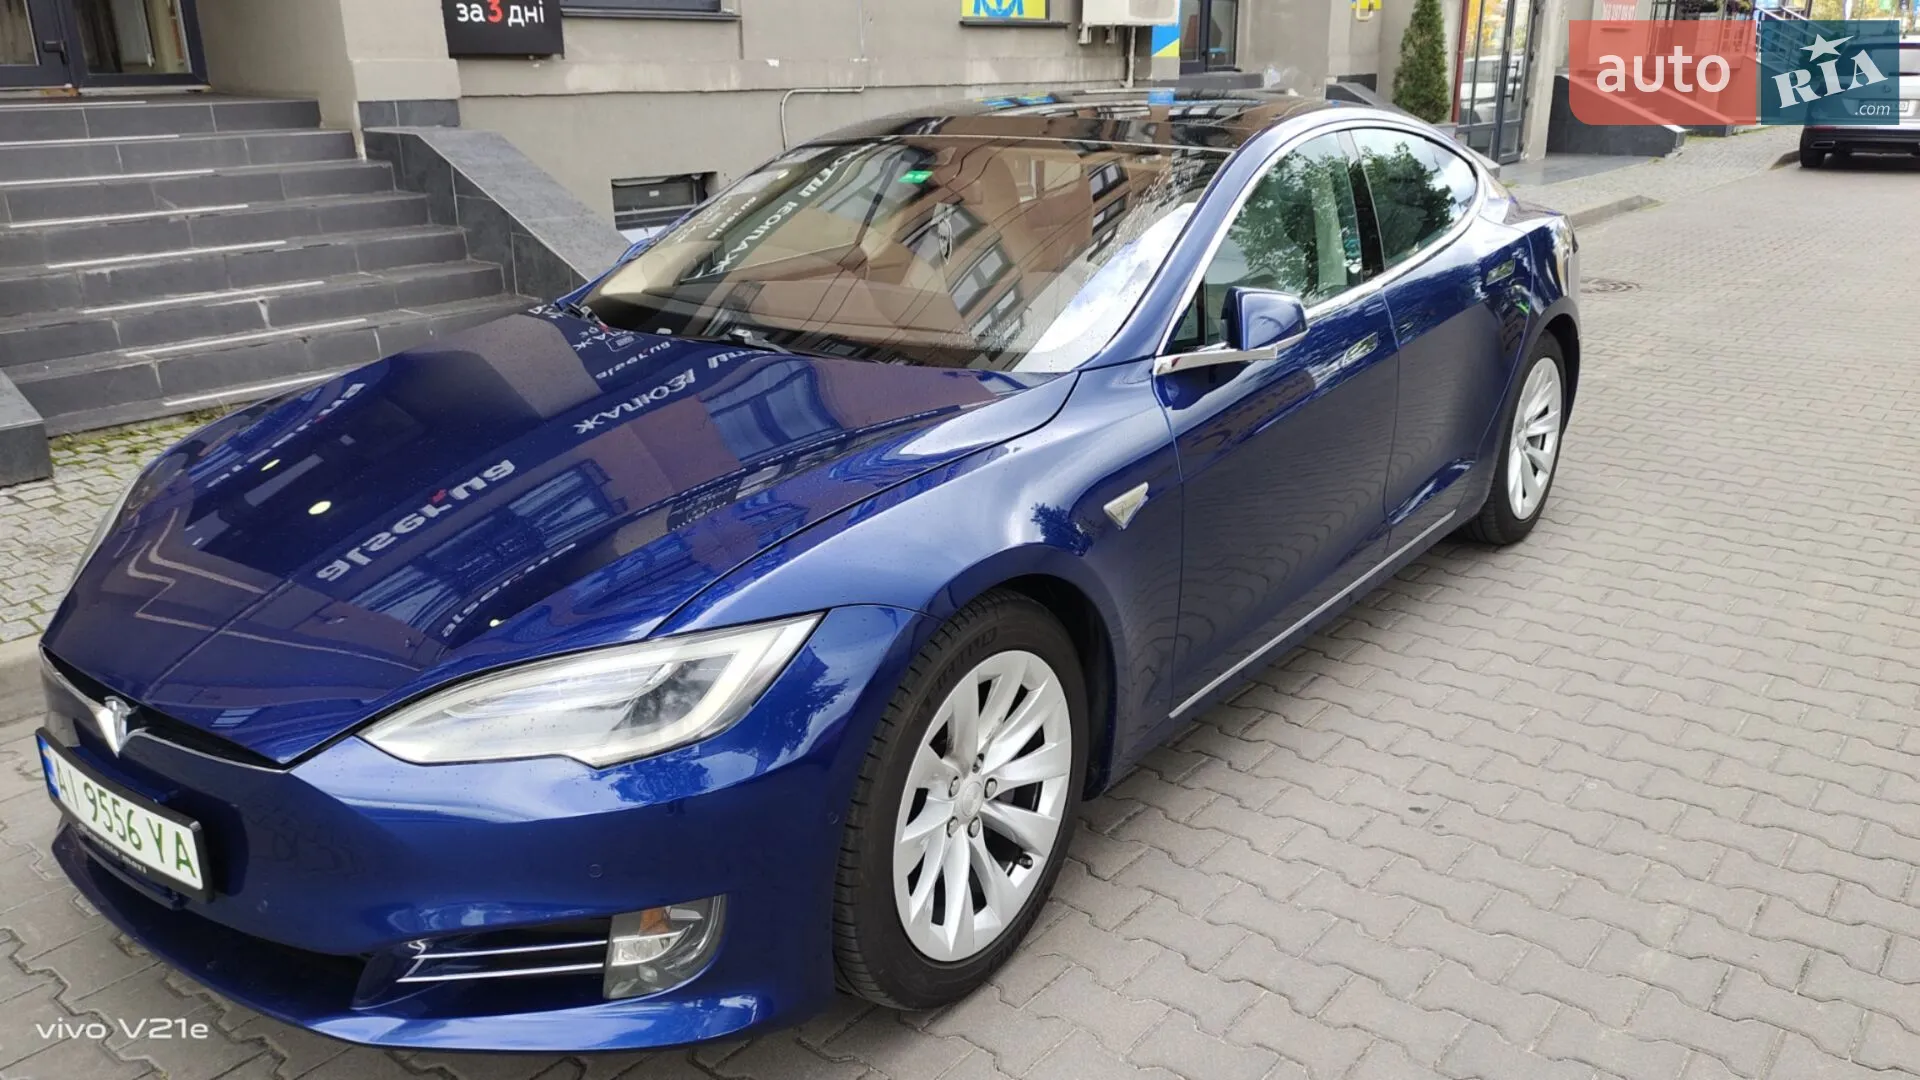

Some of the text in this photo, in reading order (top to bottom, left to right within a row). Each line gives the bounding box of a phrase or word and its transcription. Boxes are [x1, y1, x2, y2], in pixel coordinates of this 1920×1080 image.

[507, 0, 544, 27] дні
[55, 758, 79, 811] AI
[84, 781, 142, 851] 9556
[146, 817, 197, 879] YA
